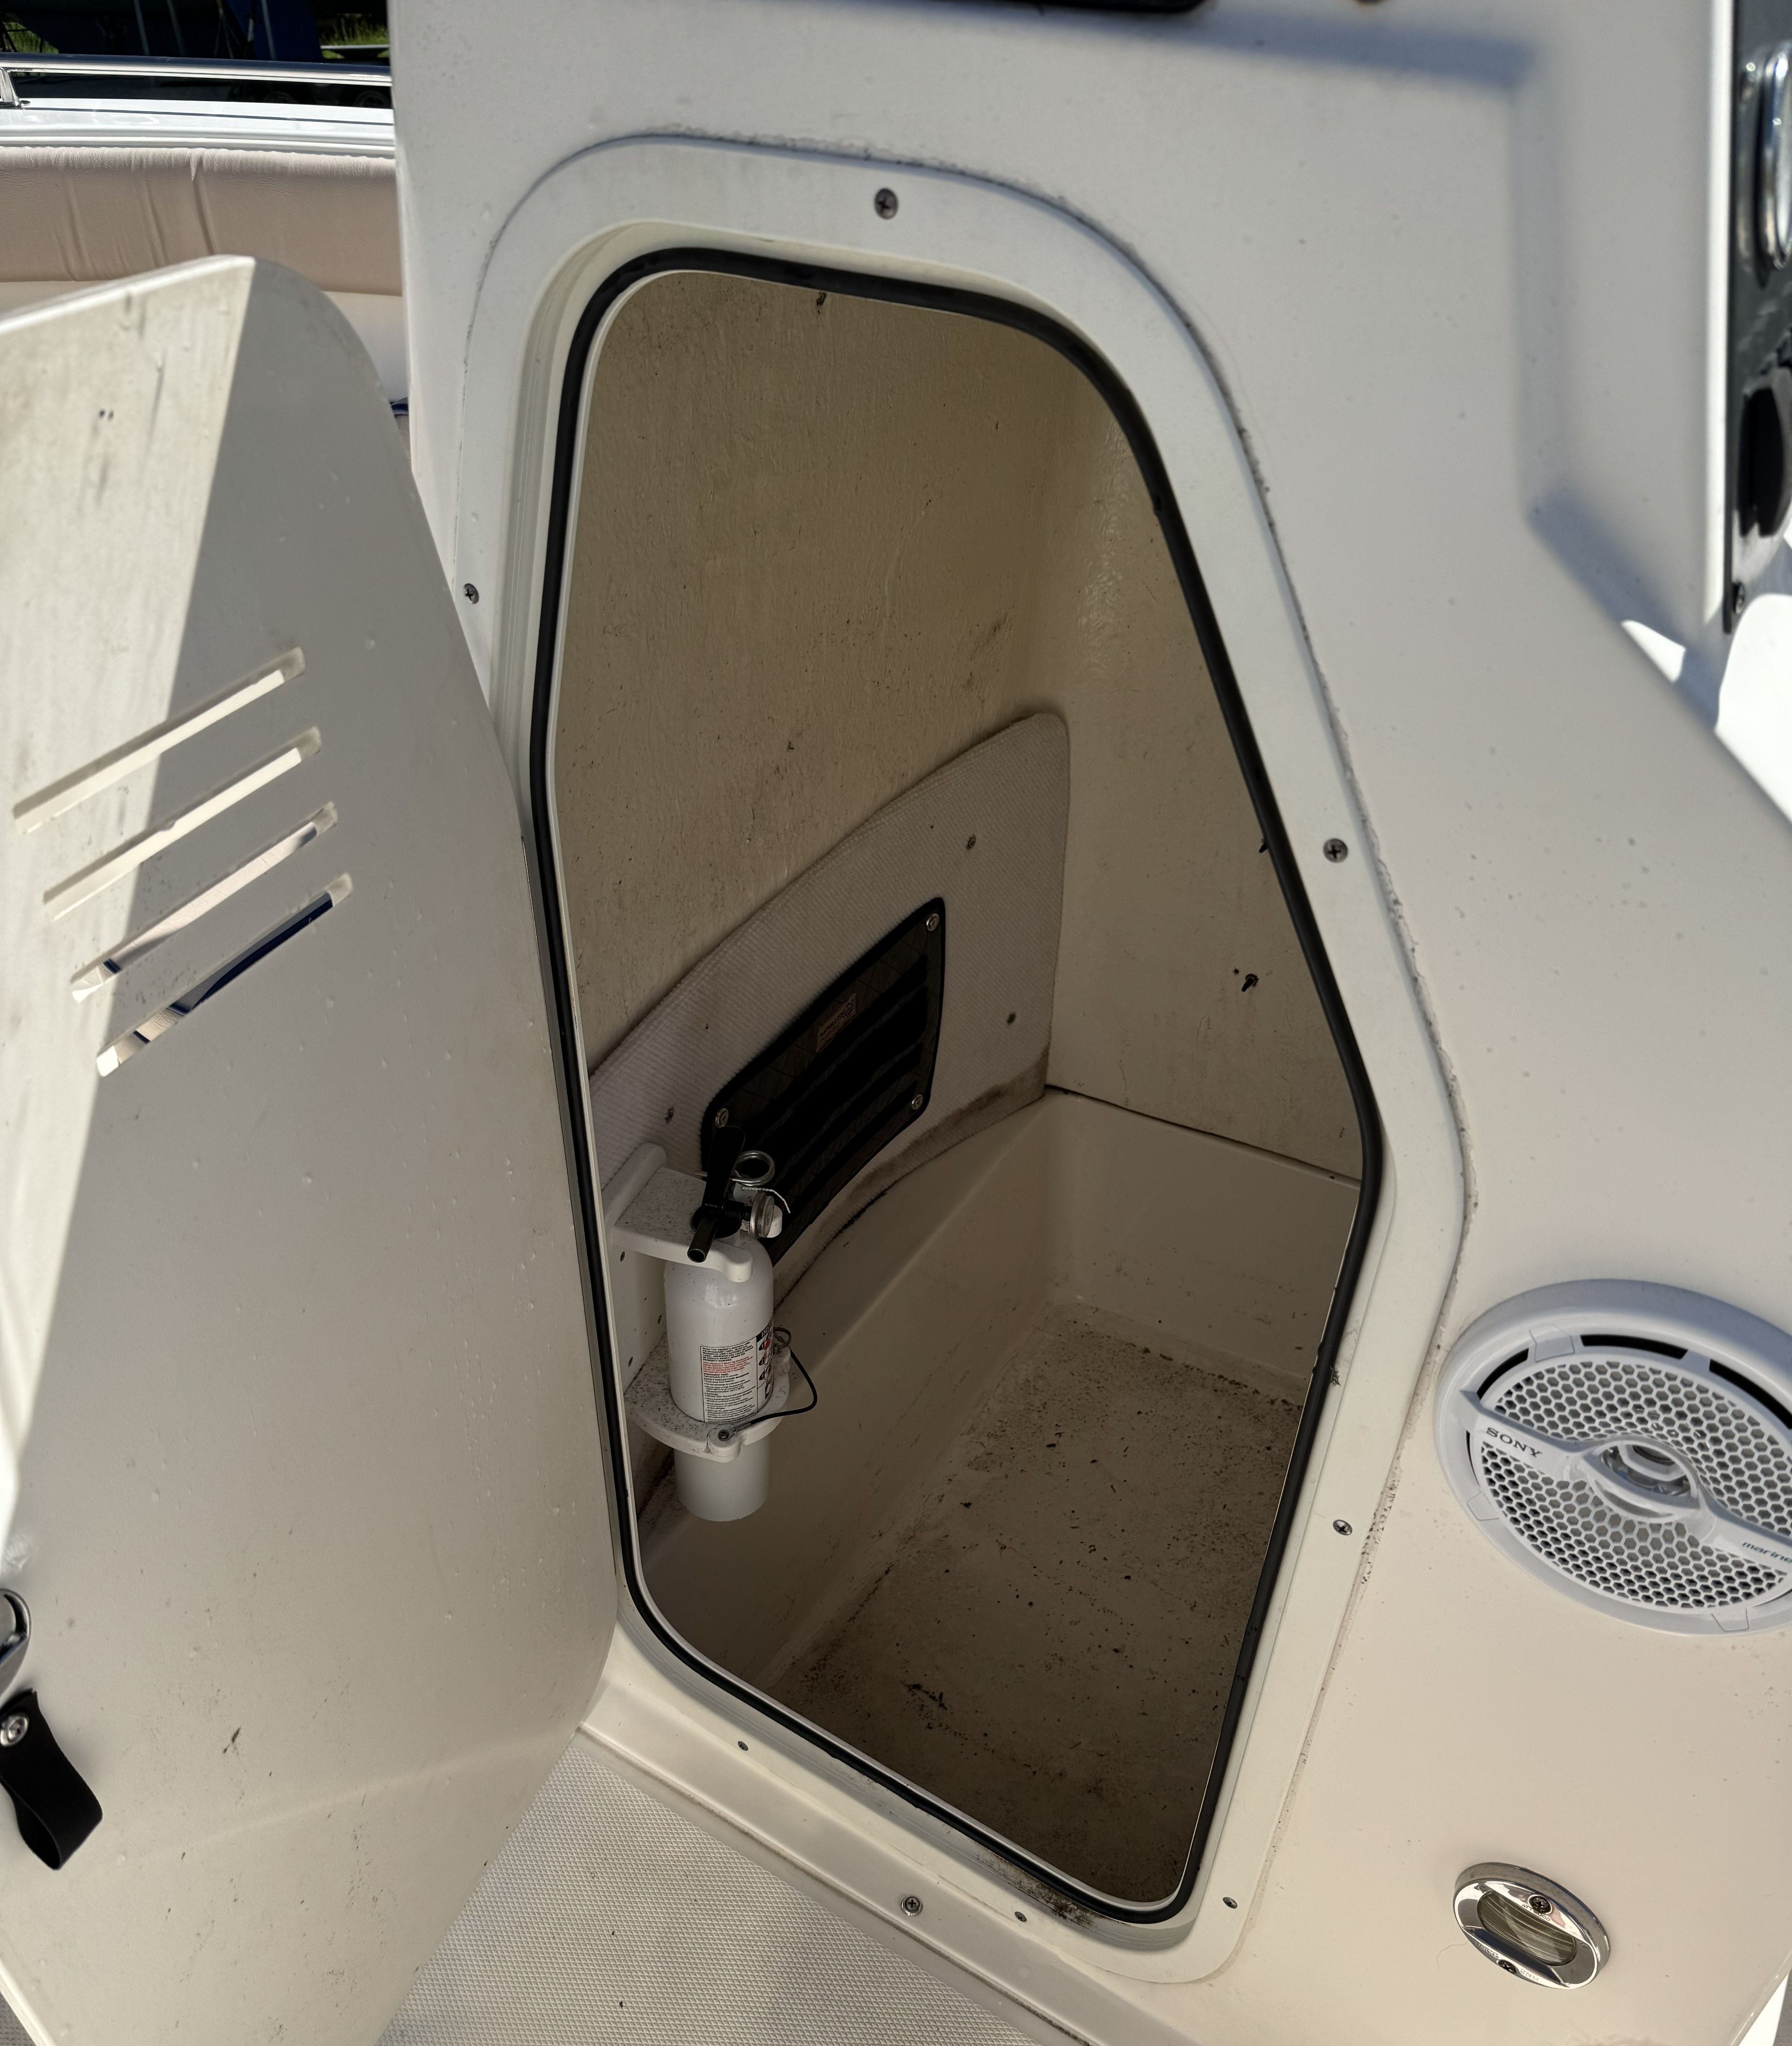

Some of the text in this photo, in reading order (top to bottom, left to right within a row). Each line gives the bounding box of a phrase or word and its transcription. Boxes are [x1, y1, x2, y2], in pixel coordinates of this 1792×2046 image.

[1486, 1427, 1542, 1458] SONY
[1742, 1542, 1792, 1563] marine
[1520, 1968, 1539, 1982] 2NM
